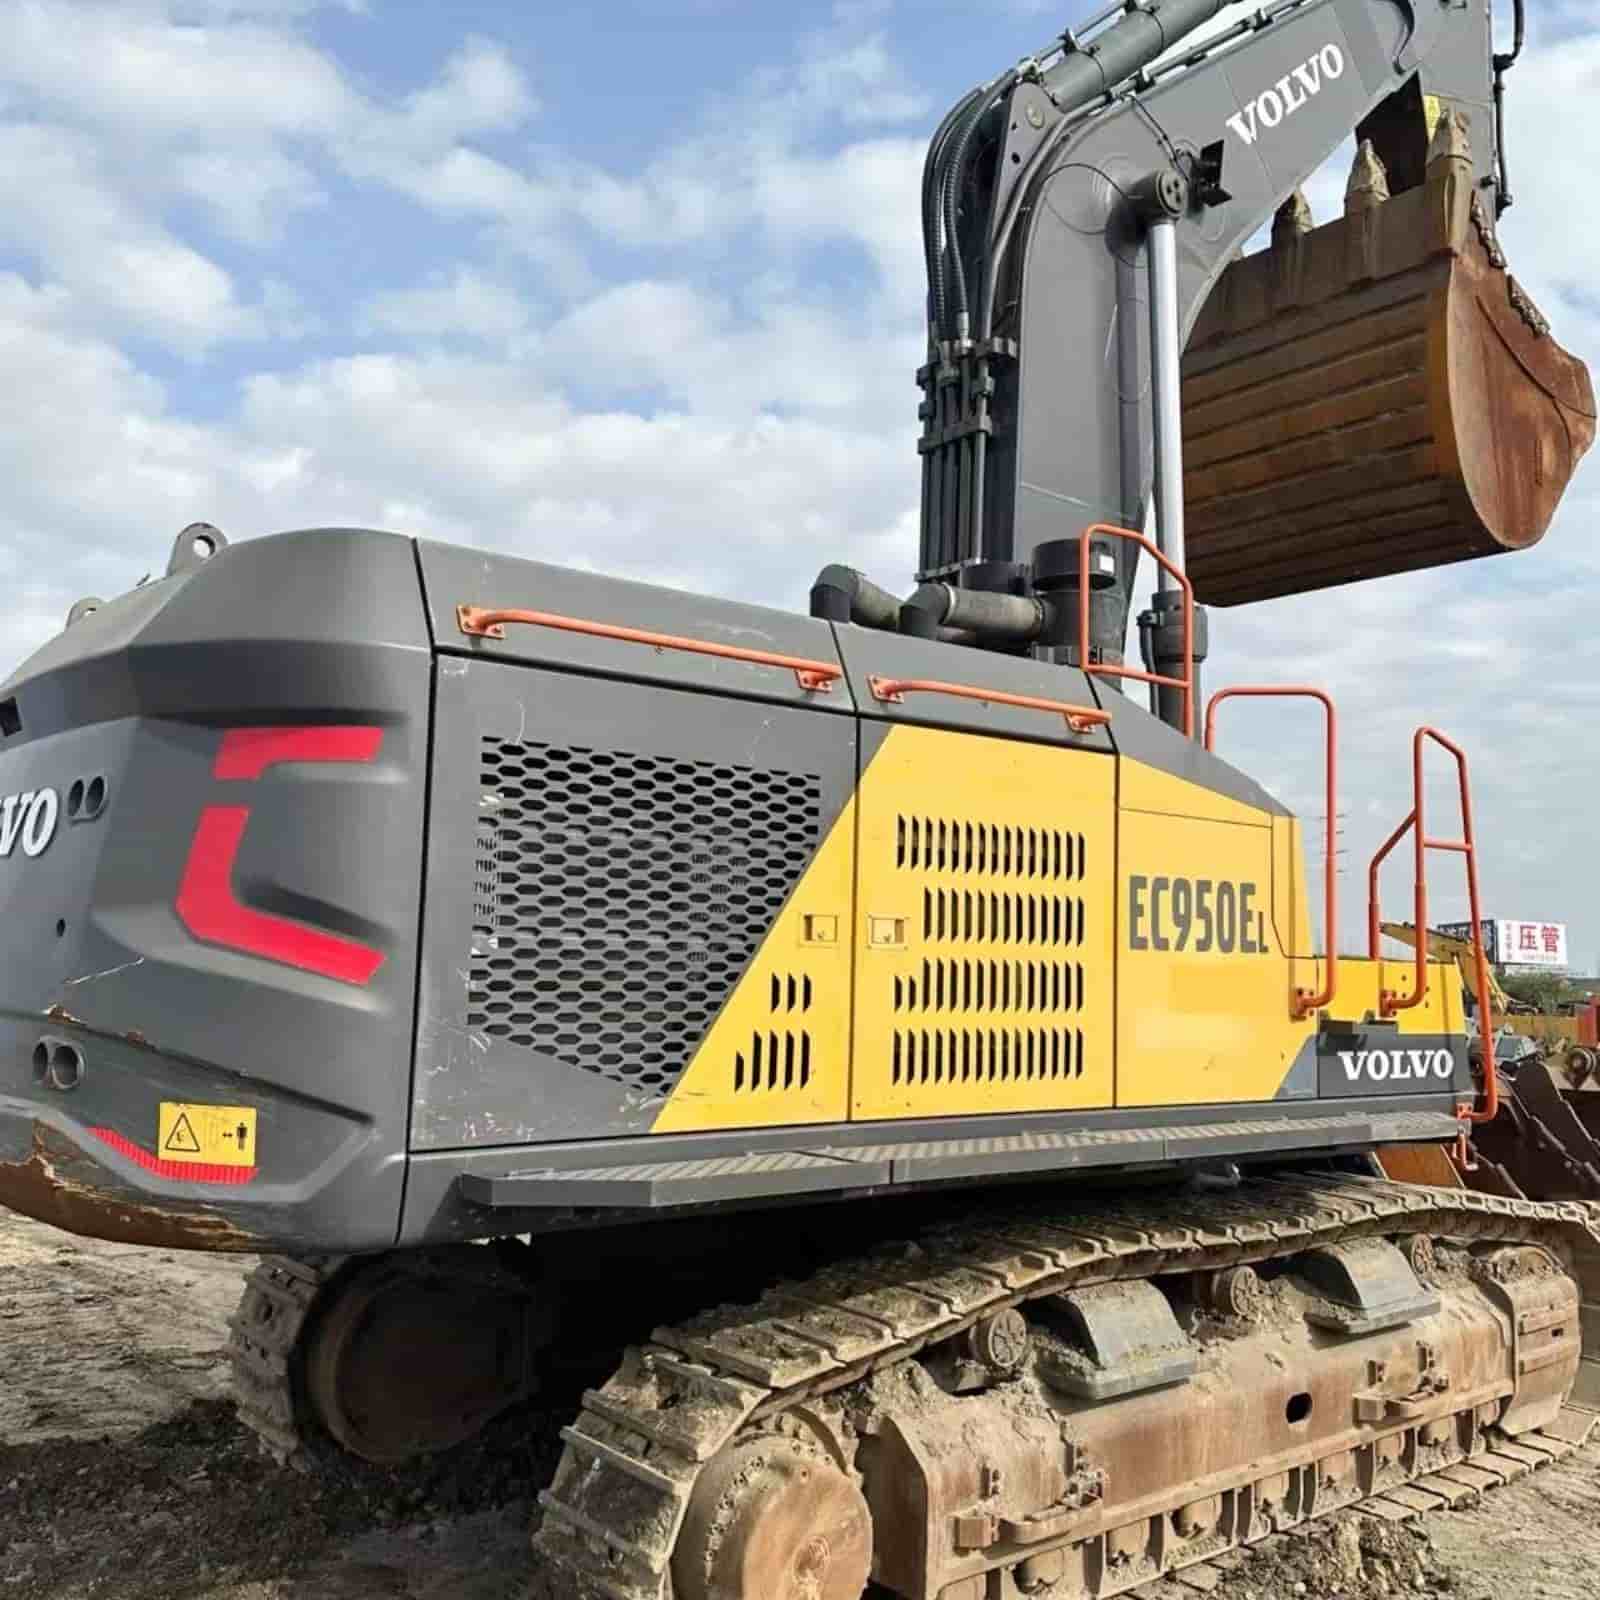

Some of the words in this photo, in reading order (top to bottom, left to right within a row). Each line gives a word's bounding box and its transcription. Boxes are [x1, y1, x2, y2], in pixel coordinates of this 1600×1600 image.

[1225, 43, 1344, 145] VOLVO
[1519, 924, 1560, 953] 压管
[1336, 1048, 1454, 1080] VOLVO
